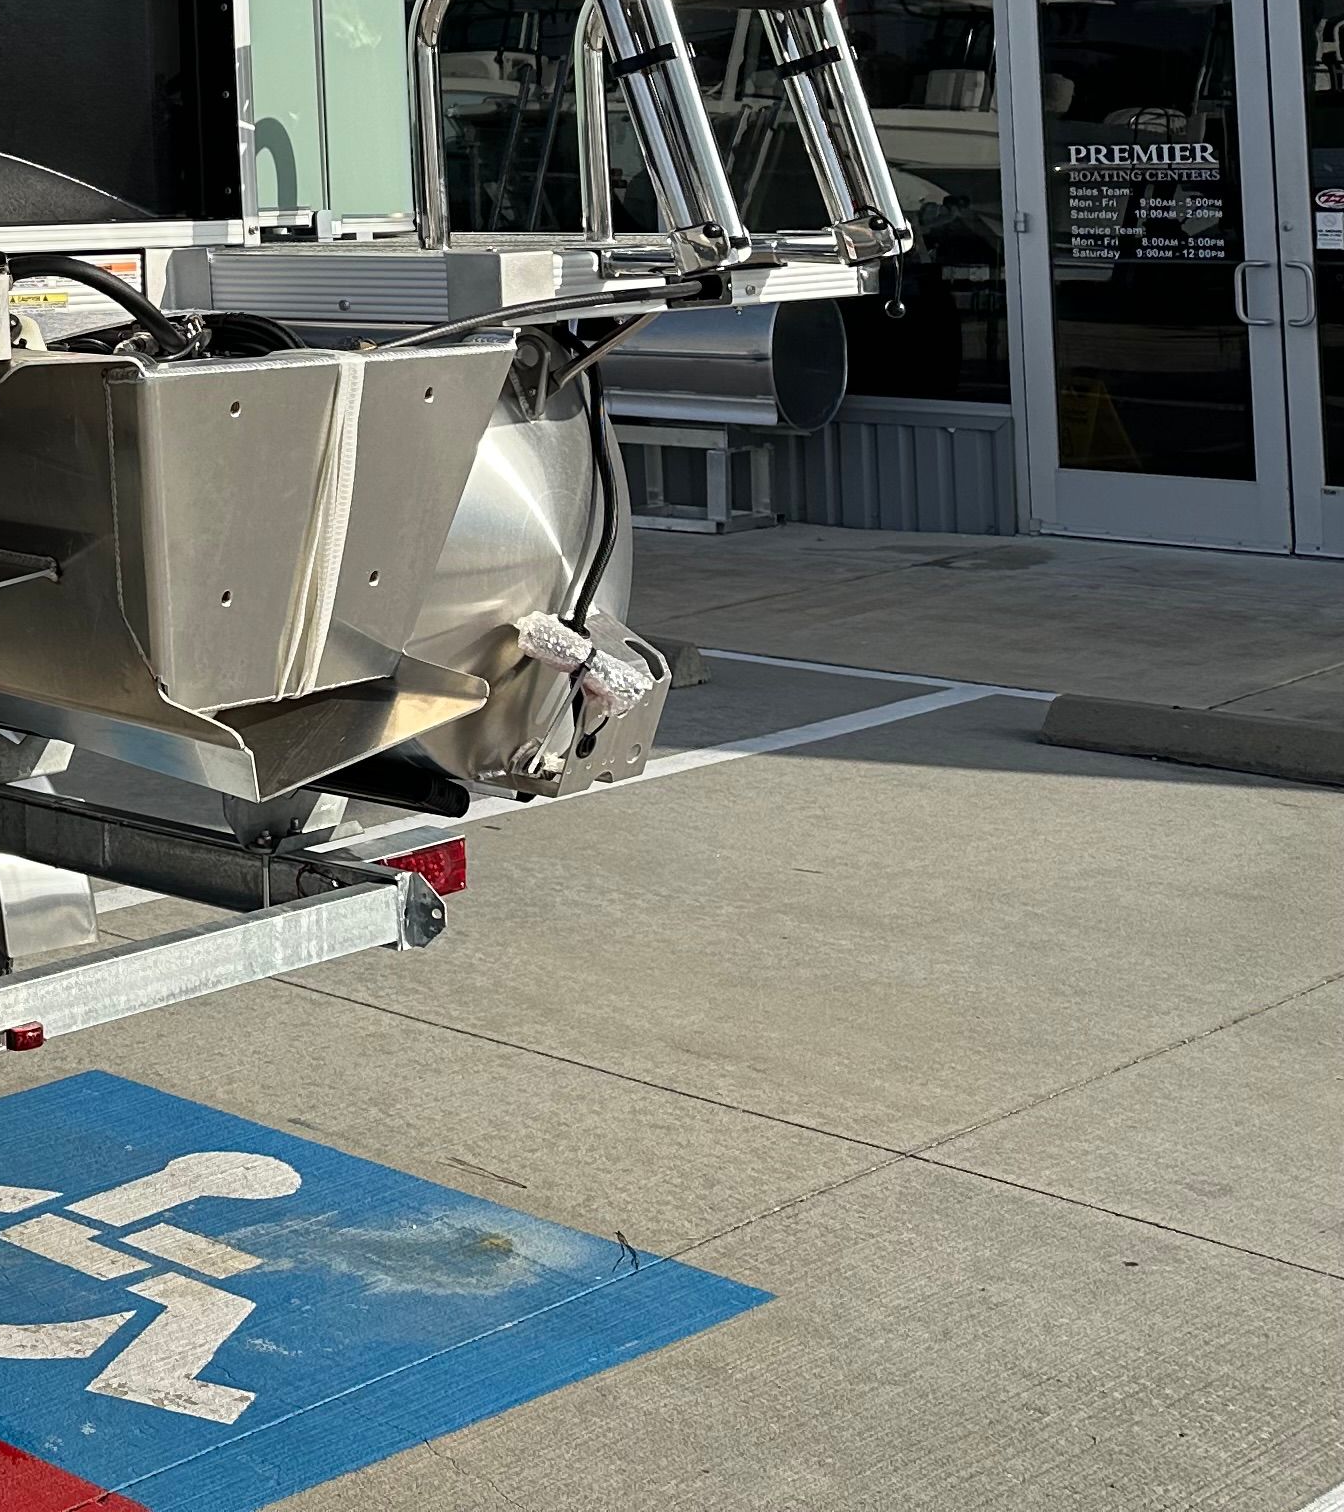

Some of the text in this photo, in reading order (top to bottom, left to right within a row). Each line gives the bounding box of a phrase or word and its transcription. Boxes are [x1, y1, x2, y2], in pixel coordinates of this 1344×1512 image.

[1067, 142, 1220, 165] PREMIER
[1069, 169, 1221, 182] BOATING CENTERS
[1069, 187, 1099, 196] Sales
[1069, 199, 1093, 207] Mon
[1102, 199, 1117, 207] Fri
[1070, 210, 1119, 220] Saturday
[1072, 225, 1111, 235] Service
[1072, 238, 1095, 246] Mon
[1104, 237, 1119, 246] Fri
[1072, 249, 1121, 259] Saturday
